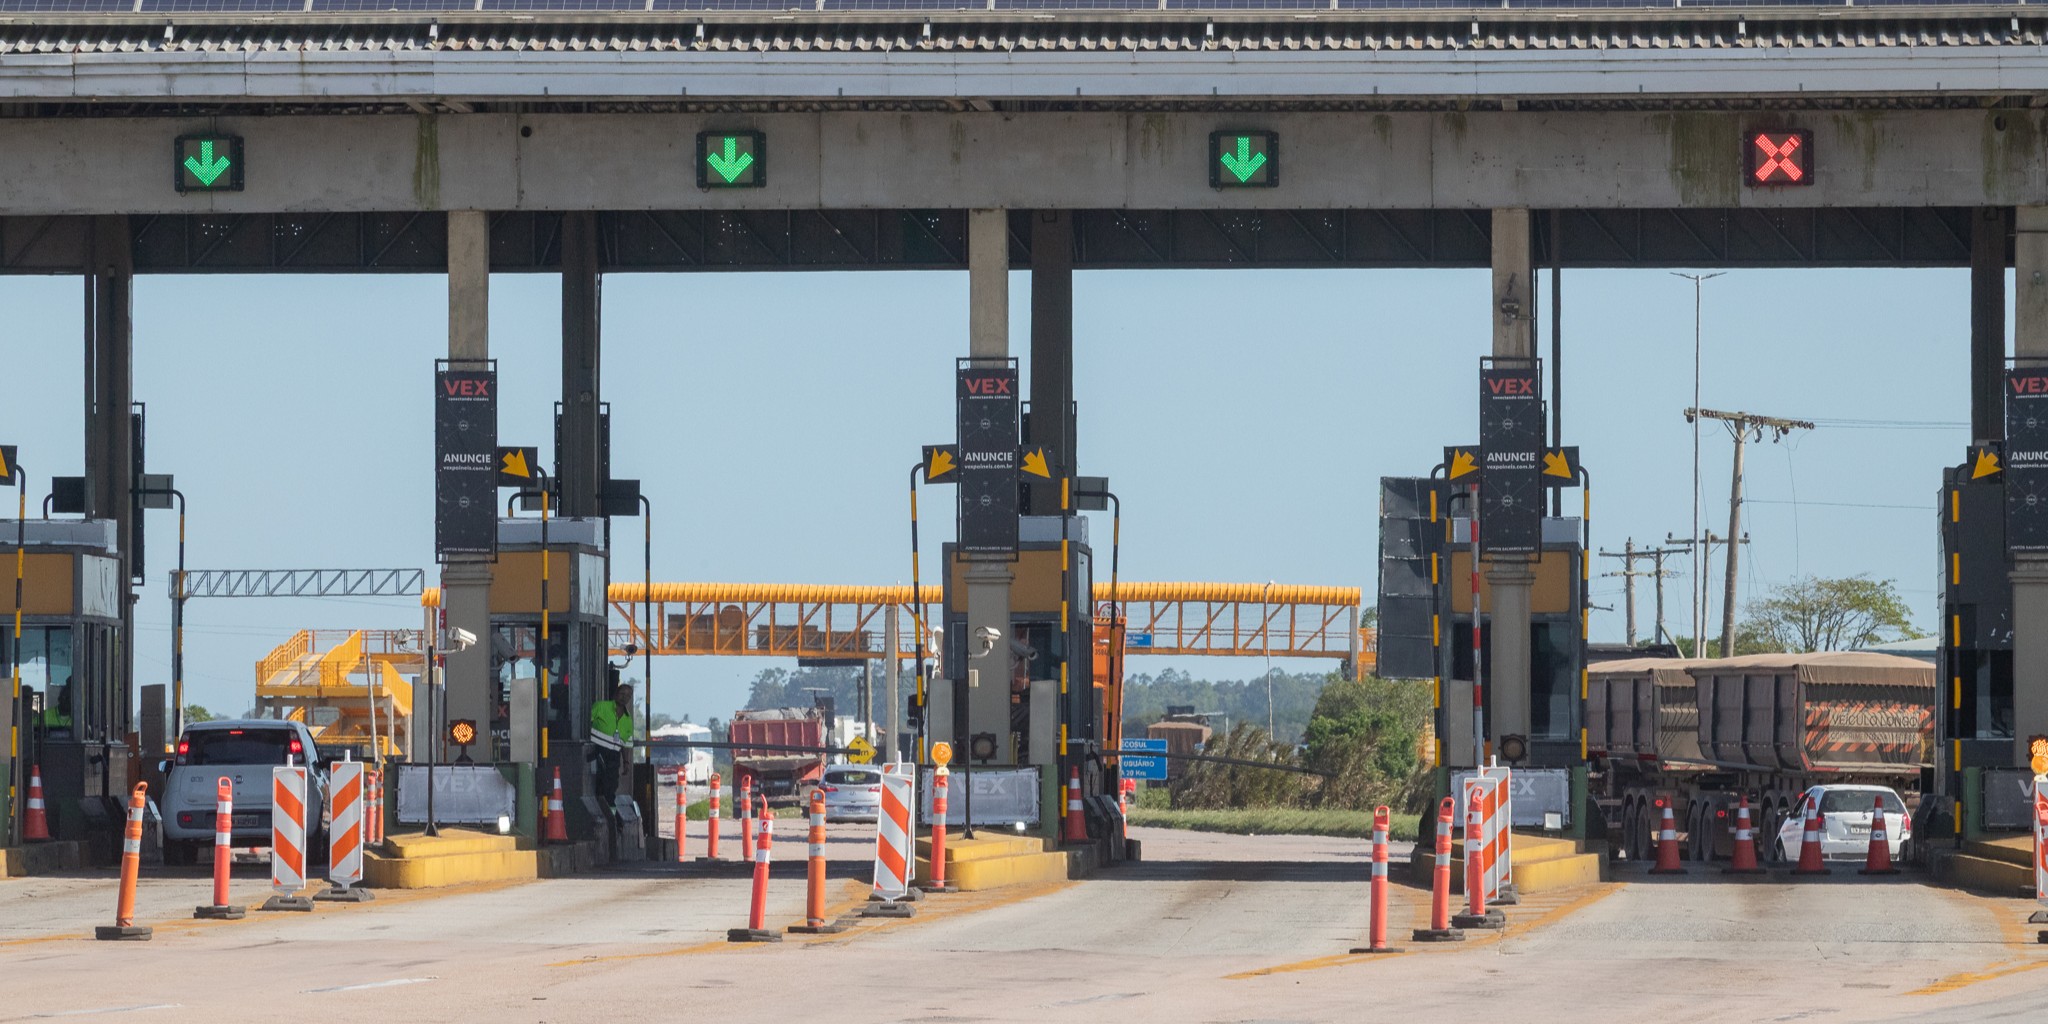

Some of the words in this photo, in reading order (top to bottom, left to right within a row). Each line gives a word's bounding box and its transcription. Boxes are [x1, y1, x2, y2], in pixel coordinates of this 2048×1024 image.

[444, 380, 489, 396] VEX
[965, 378, 1010, 394] VEX
[1488, 378, 1533, 394] VEX
[443, 453, 491, 463] ANUNCIE
[965, 452, 1013, 462] ANUNCIE
[1487, 452, 1535, 462] ANUNCIE
[433, 775, 482, 792] VEX
[1510, 778, 1535, 795] EX
